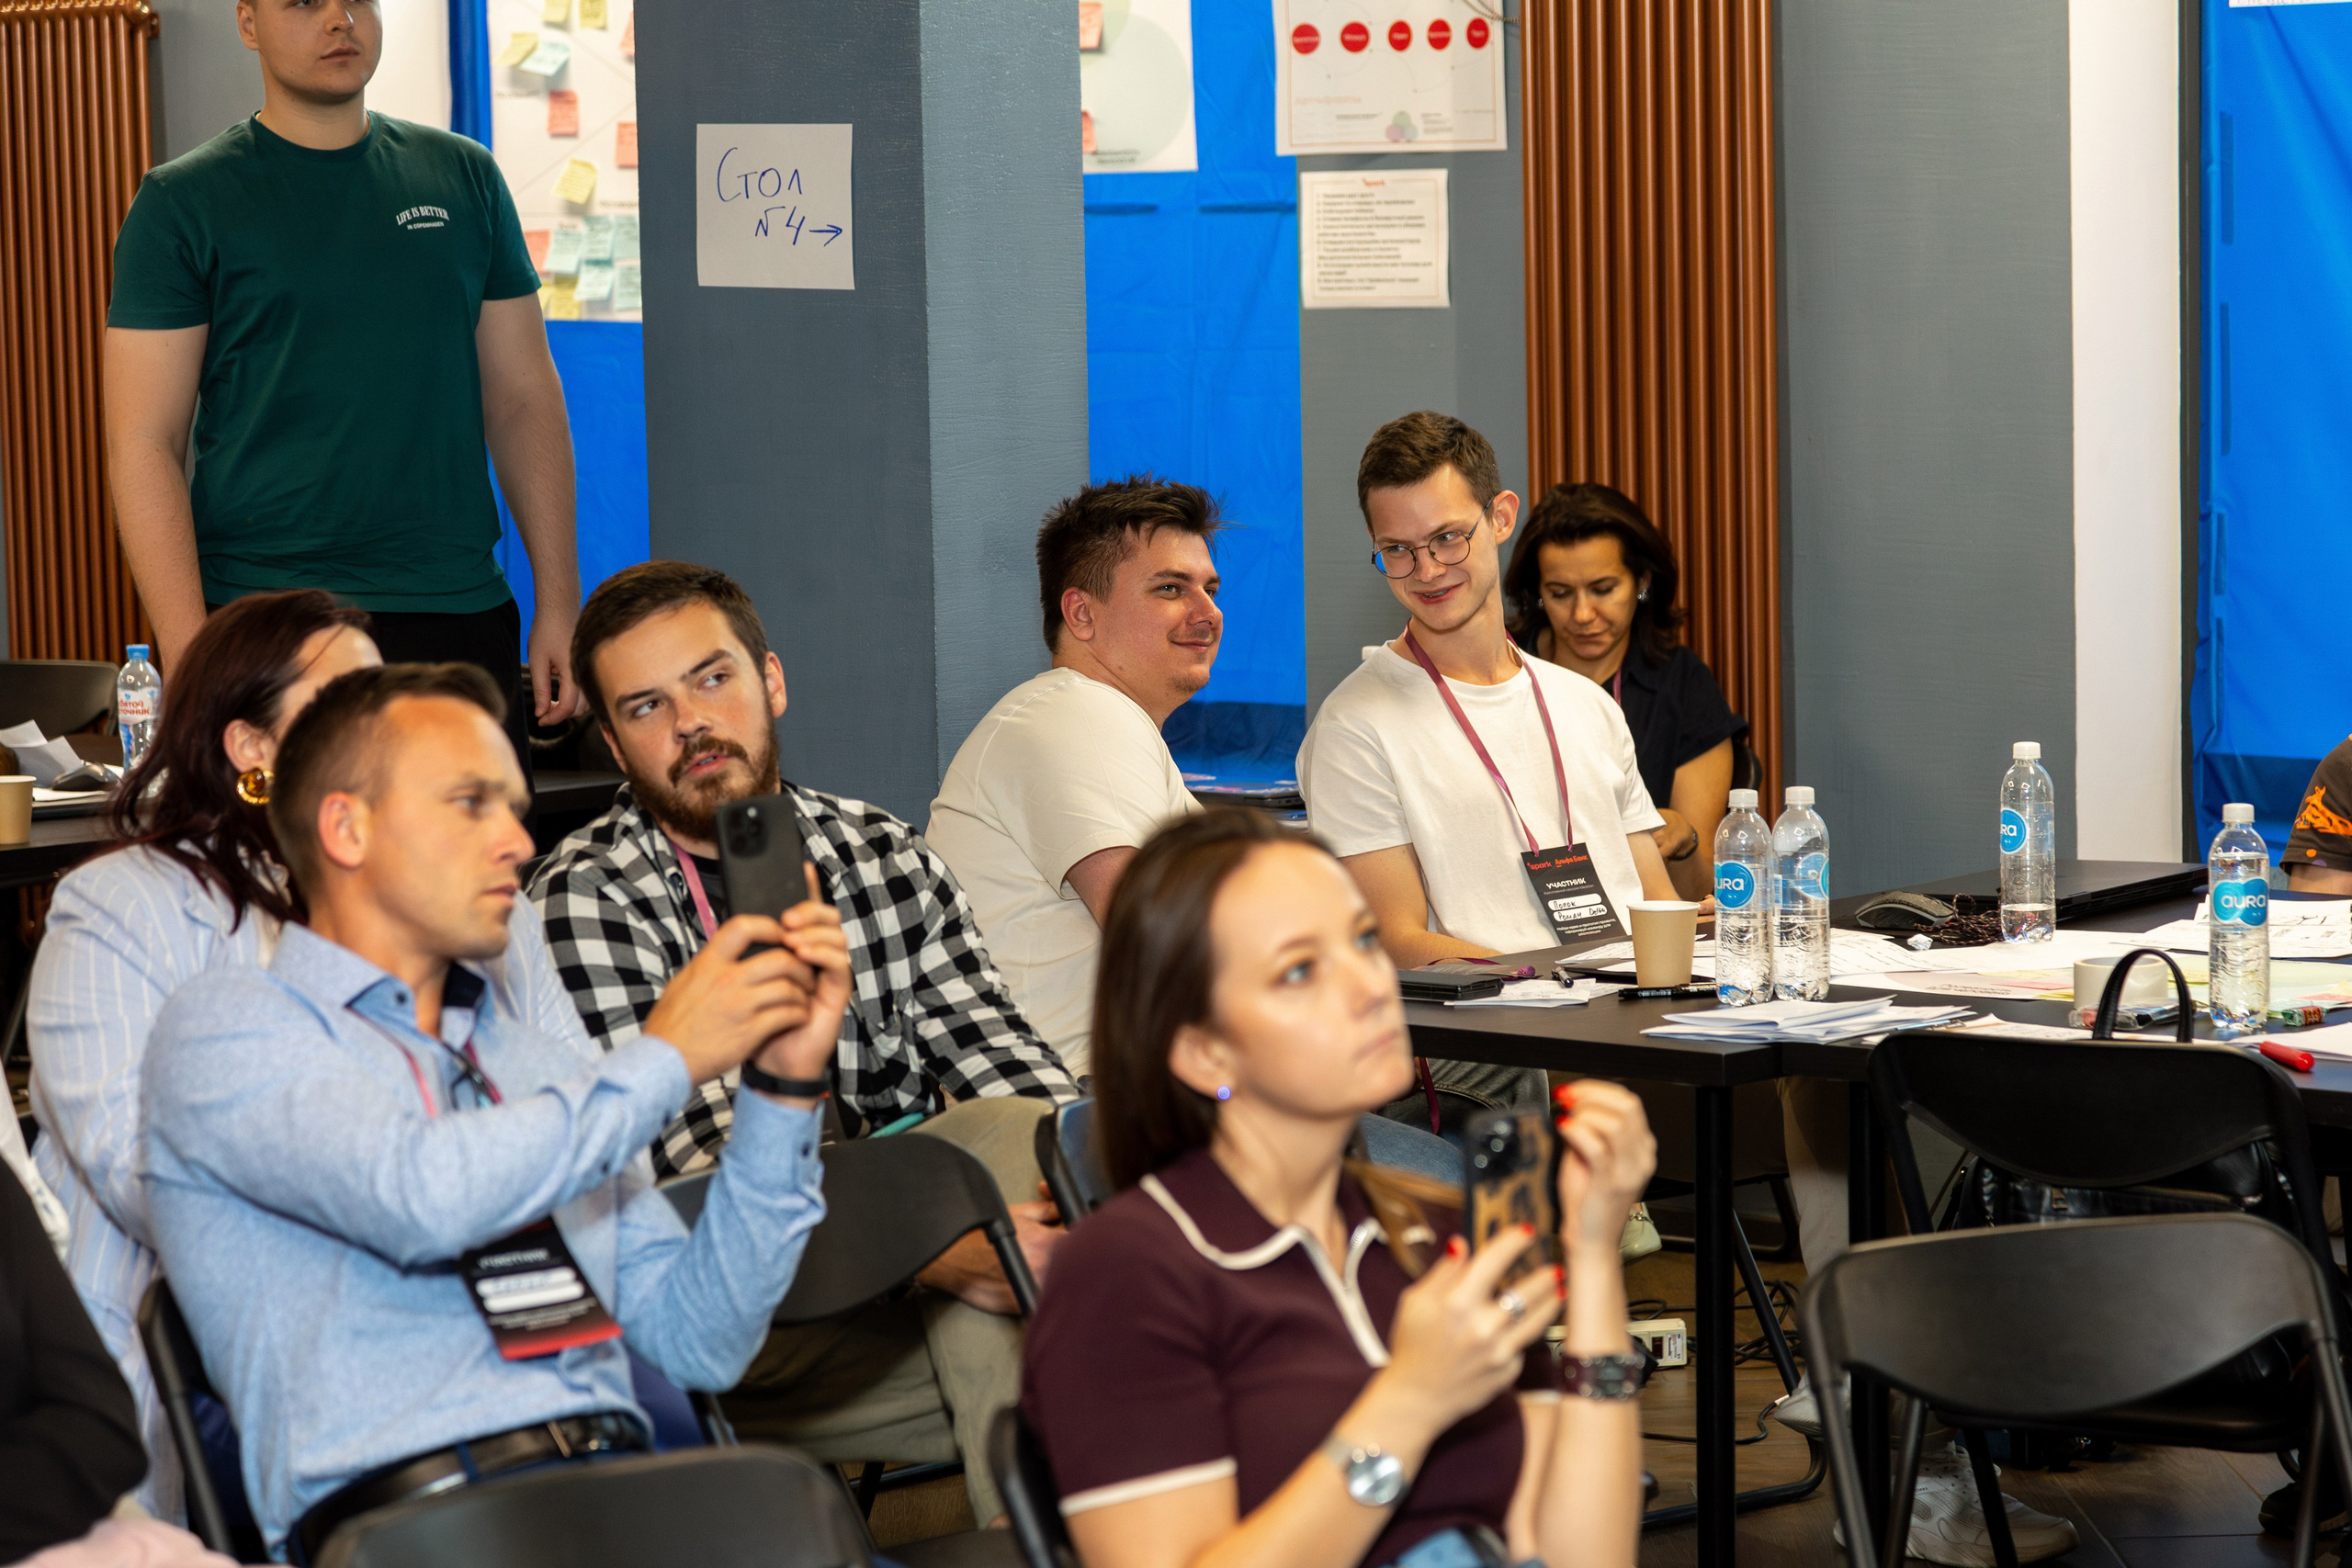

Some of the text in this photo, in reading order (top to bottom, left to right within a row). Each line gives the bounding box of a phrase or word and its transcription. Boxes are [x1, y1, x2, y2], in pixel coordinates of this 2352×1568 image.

[717, 147, 803, 202] Стол
[396, 206, 449, 226] LIFE IS BETTER
[1545, 877, 1587, 889] УЧАСТНИК
